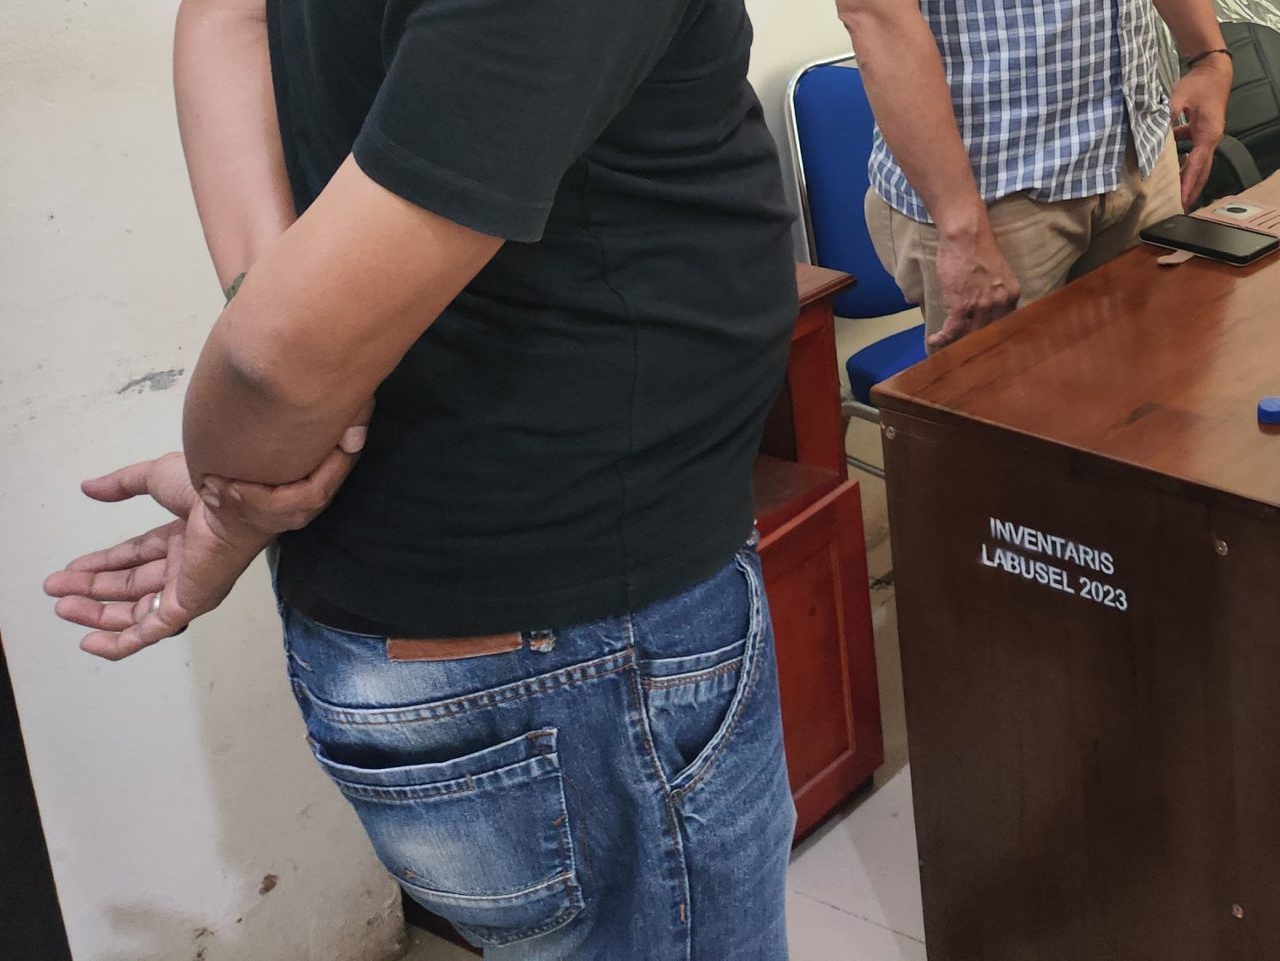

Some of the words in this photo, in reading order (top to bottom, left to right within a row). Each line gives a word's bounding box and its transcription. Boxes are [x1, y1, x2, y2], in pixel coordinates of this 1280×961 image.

[981, 543, 1075, 594] LABUSEL
[1079, 577, 1128, 611] 2023
[990, 516, 1115, 575] INVENTARIS
